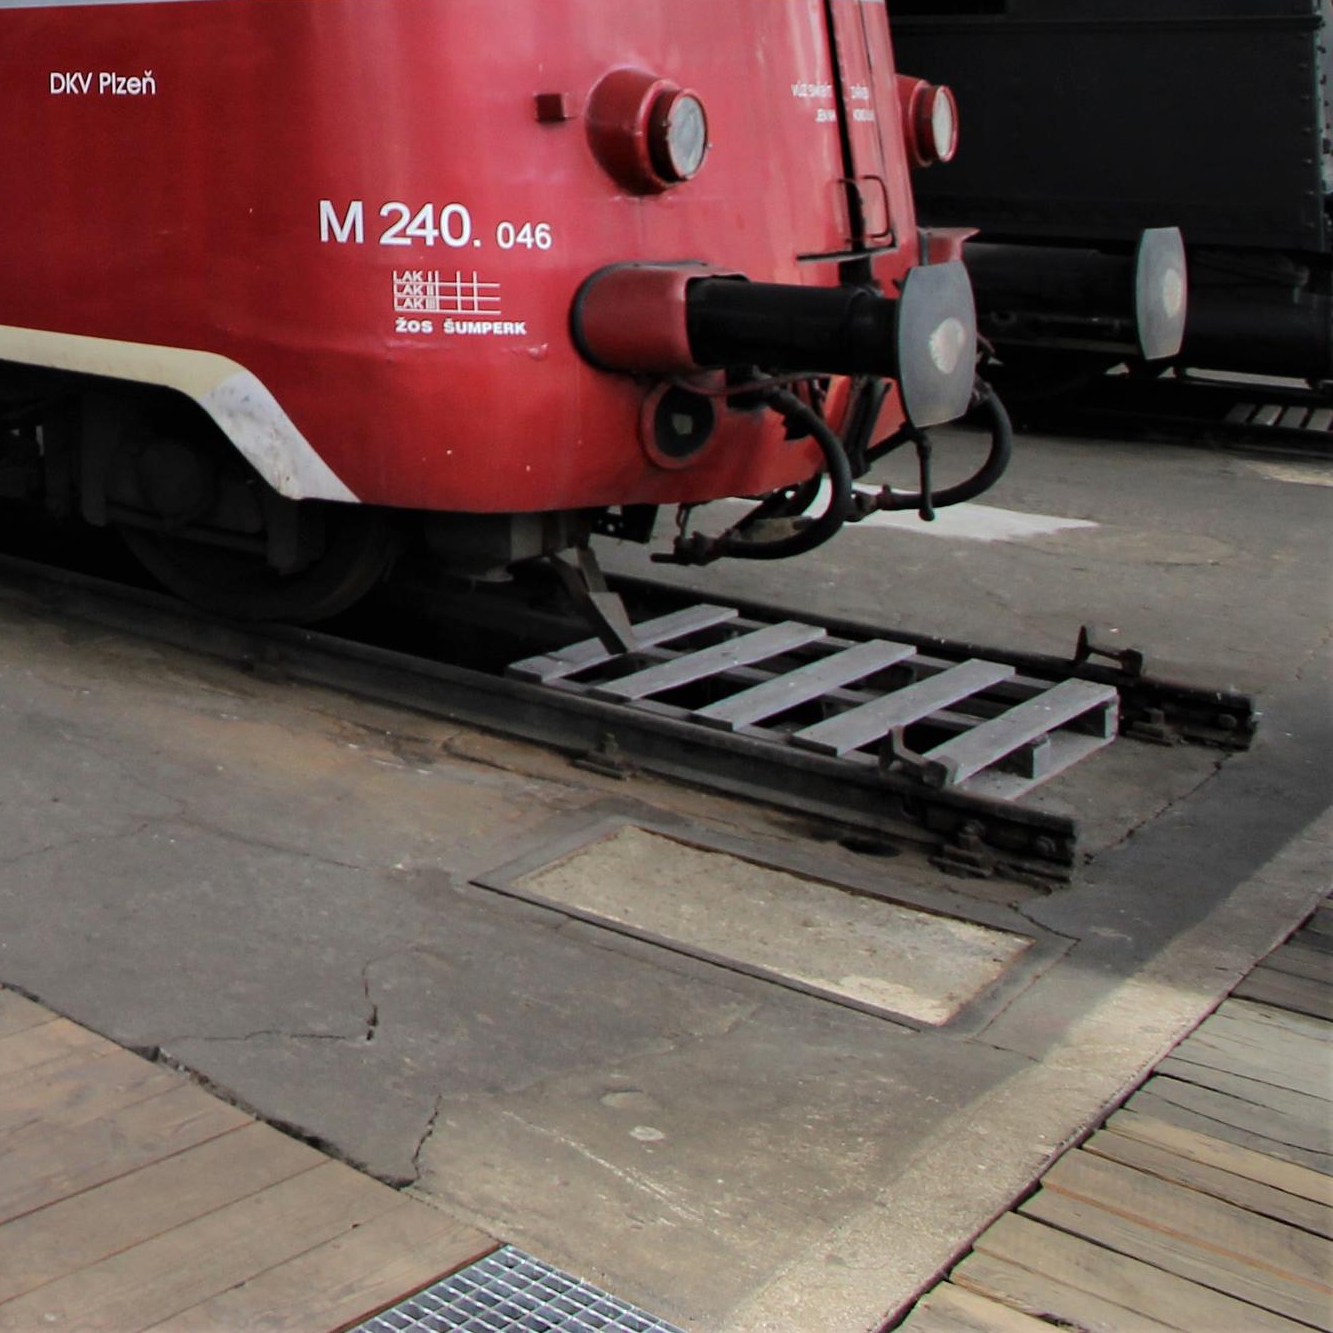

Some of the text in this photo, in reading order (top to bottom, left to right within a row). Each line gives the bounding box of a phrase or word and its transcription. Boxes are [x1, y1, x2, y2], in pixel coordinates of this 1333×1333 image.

[50, 69, 156, 95] DKV Plzeň
[319, 200, 364, 243] M
[496, 222, 552, 250] 046
[395, 316, 528, 336] ŽOS ŠUMPERK
